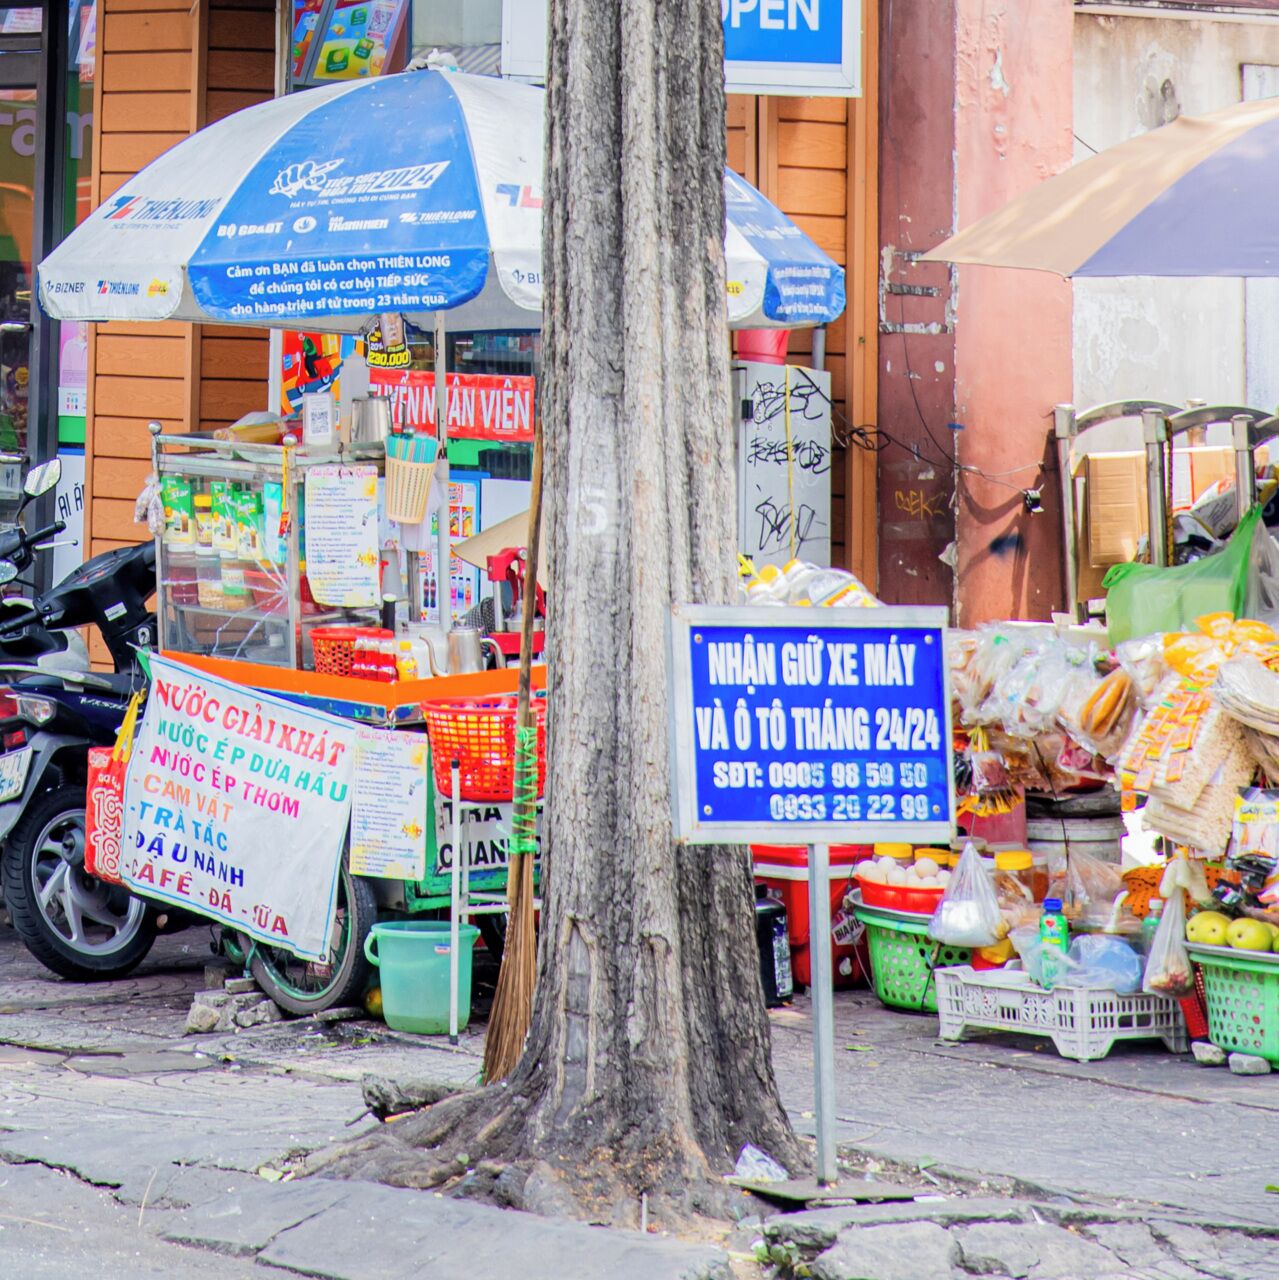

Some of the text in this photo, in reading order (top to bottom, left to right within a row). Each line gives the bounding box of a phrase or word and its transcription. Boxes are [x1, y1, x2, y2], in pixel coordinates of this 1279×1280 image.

[226, 254, 451, 278] Cảm ơn BẠN đã luôn chọn THIÊN LONG
[55, 281, 86, 293] BIZNER
[267, 280, 303, 295] chúng
[305, 278, 322, 291] tôi
[323, 277, 337, 290] có
[339, 278, 354, 290] cơ
[356, 275, 375, 291] hội
[377, 274, 402, 288] TIẾP
[403, 273, 429, 286] SỨC
[231, 303, 253, 315] cho
[254, 299, 286, 315] hàng
[287, 300, 314, 314] triệu
[343, 296, 375, 311] trong
[377, 295, 391, 306] 23
[393, 293, 420, 305] năm
[421, 295, 449, 307] qua.
[367, 351, 410, 366] 230.000
[480, 378, 530, 430] VIÊN
[708, 634, 916, 695] NHẬN GIỮ XE MÁY
[155, 678, 346, 768] NƯỚC GIẢI KHÁT
[696, 697, 940, 751] VÀ Ô TÔ THÁNG 24/24
[158, 717, 348, 803] NƯỚC ÉP DƯA HẤU
[713, 761, 764, 788] SĐT:
[768, 761, 825, 788] 0905
[831, 761, 860, 788] 98
[143, 773, 191, 807] CAM
[149, 745, 207, 783] NƯỚC
[211, 767, 237, 794] ÉP
[238, 780, 301, 819] THƠM
[769, 793, 826, 820] 0933
[866, 793, 896, 820] 22
[900, 793, 929, 820] 99
[138, 800, 229, 852] TRÀ TẮC
[193, 849, 245, 888] NÀNH
[208, 887, 233, 914] ĐÁ
